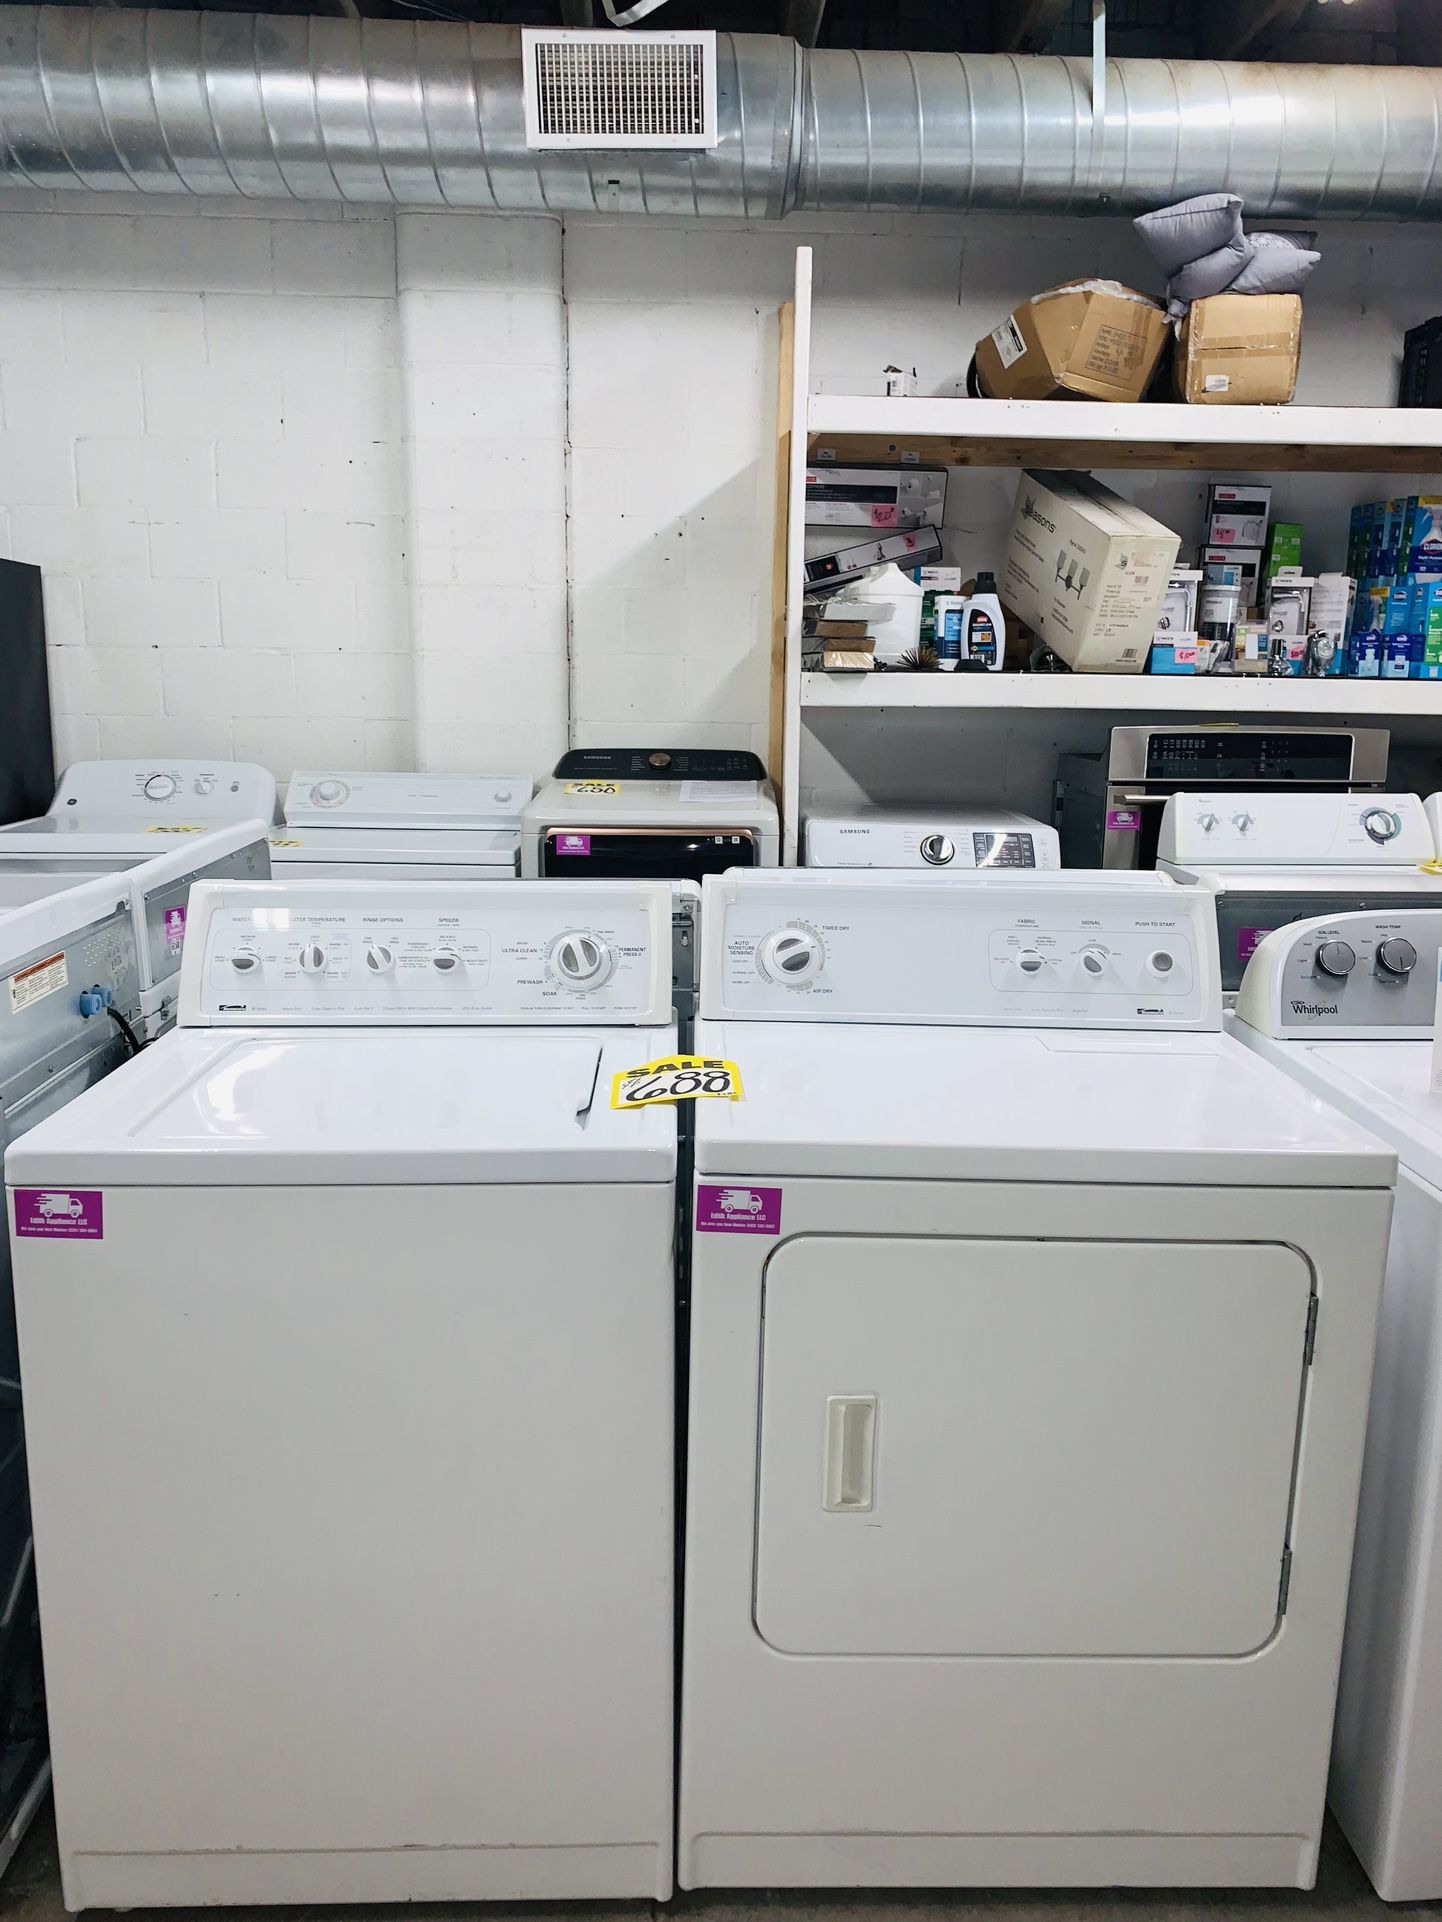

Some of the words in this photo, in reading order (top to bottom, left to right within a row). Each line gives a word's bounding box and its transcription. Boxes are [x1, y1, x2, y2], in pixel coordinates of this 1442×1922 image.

[1292, 1004, 1338, 1016] Whirlpool
[626, 1060, 725, 1078] SALE
[626, 1070, 731, 1102] 688
[726, 1213, 756, 1221] Appliance
